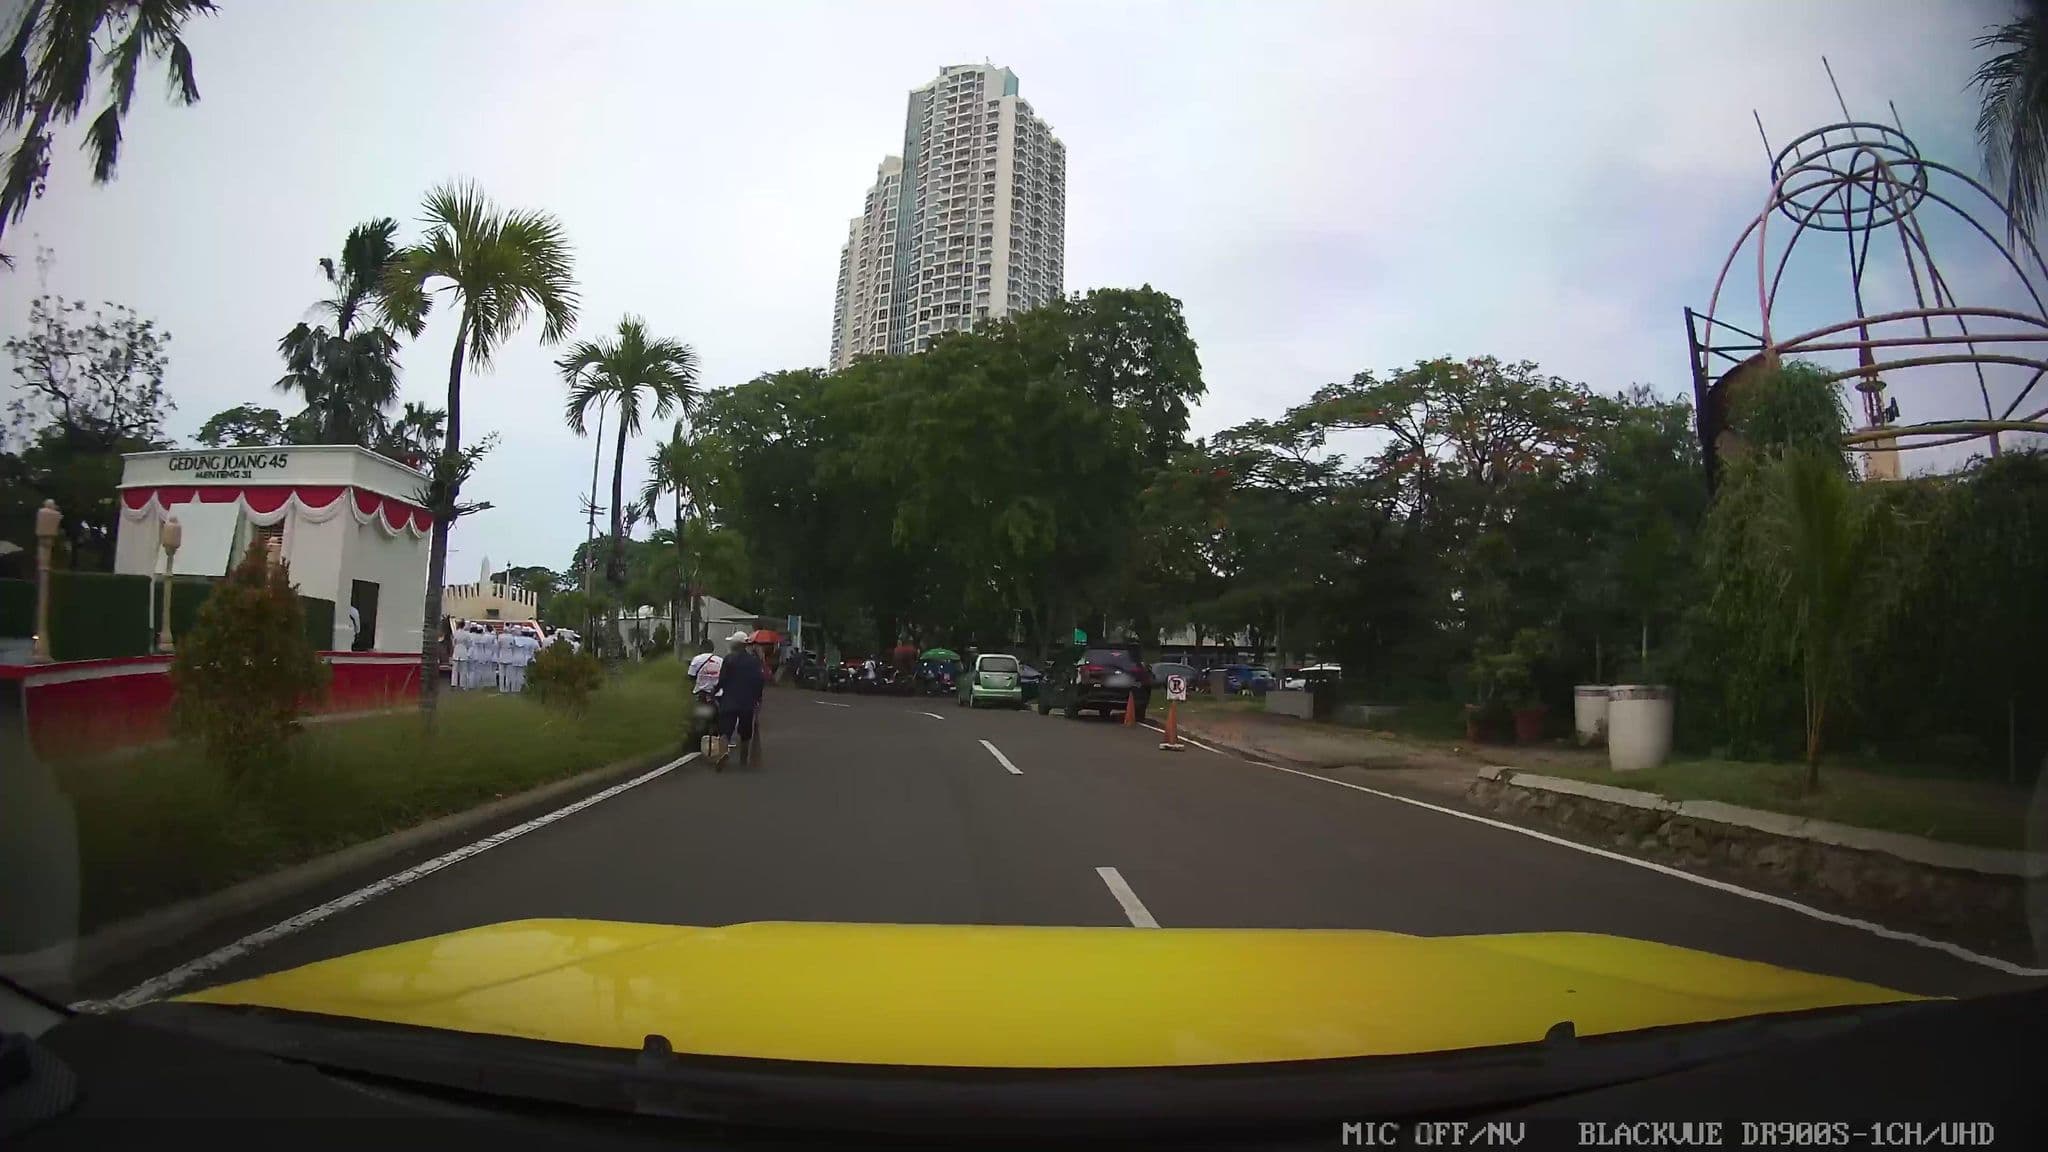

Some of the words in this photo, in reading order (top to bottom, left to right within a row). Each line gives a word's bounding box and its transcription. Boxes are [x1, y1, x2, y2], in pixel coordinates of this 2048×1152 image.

[169, 456, 220, 471] GEDUNG
[222, 454, 267, 469] JOANG
[269, 454, 289, 468] 45
[195, 470, 240, 479] MENTENG
